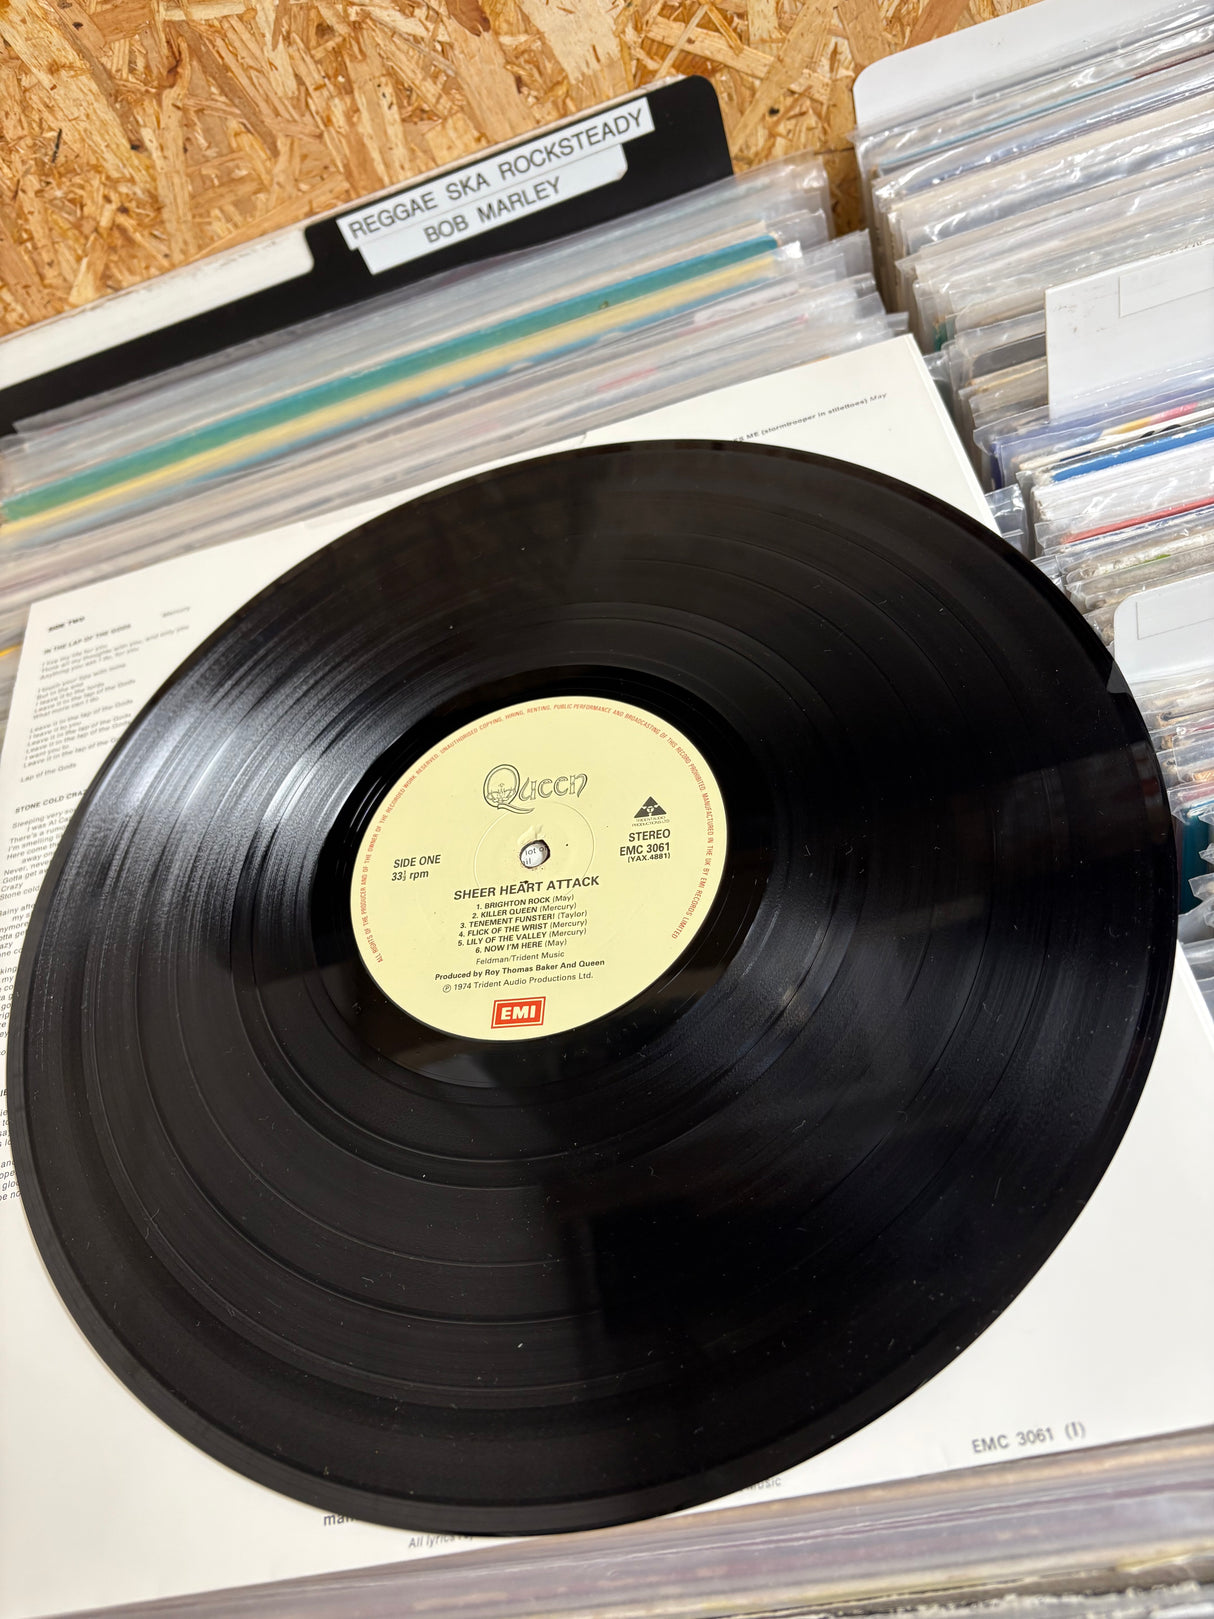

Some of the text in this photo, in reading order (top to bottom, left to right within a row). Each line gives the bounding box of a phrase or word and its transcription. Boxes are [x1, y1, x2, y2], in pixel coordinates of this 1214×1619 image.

[349, 107, 643, 239] REGGAE SKA ROCKSTEADY
[423, 176, 561, 244] BOB MARLEY
[573, 703, 611, 714] PERFORMANCE
[612, 709, 624, 717] AND
[624, 713, 662, 735] BROADCASTING
[440, 727, 478, 754] UNAUTHORISED
[666, 737, 678, 748] THIS
[675, 746, 692, 764] RECORD
[483, 764, 588, 814] Queen
[15, 790, 86, 814] STONE COLD CRA
[386, 788, 405, 814] RECORDED
[702, 792, 714, 836] MANUFACTURED
[12, 815, 44, 830] Sleeping
[629, 828, 671, 842] STEREO
[525, 847, 536, 856] lot
[620, 842, 670, 856] EMC 3061
[706, 845, 714, 856] THE
[30, 859, 49, 869] neve
[393, 854, 441, 869] SIDE ONE
[628, 852, 671, 863] (YAX.4881)
[704, 858, 712, 866] UK
[409, 870, 429, 881] rpm
[702, 867, 710, 876] BY
[453, 875, 600, 901] SHEER HEART ATTACK
[698, 877, 708, 888] EMI
[484, 897, 527, 910] BRIGHTON
[528, 896, 550, 905] ROCK
[552, 894, 574, 903] (May)
[686, 890, 703, 917] RECORDS
[469, 917, 513, 928] TENEMENT
[557, 909, 588, 920] (Taylor)
[472, 902, 577, 920] 2. KILLER QUEEN (Mercury)
[467, 928, 489, 938] FLICK
[491, 926, 502, 935] OF
[504, 925, 520, 933] THE
[522, 922, 548, 932] WRIST
[549, 919, 588, 930] (Mercury)
[671, 916, 690, 940] LIMITED
[366, 935, 379, 954] RIGHTS
[457, 928, 587, 947] 5. LILY OF THE VALLEY (Mercury)
[475, 938, 567, 954] 6. NOW I'M HERE (May)
[375, 953, 384, 963] ALL
[476, 950, 565, 965] Feldman/Trident Music
[435, 959, 605, 981] Produced by Roy Thomas Baker And Queen
[454, 982, 472, 991] 1974
[474, 980, 501, 989] Trident
[503, 977, 527, 986] Audio
[529, 973, 577, 984] Productions
[578, 971, 594, 980] Ltd.
[500, 1005, 536, 1021] EMI
[972, 1434, 1009, 1453] EMC
[1016, 1427, 1054, 1446] 3061
[409, 1535, 424, 1548] All
